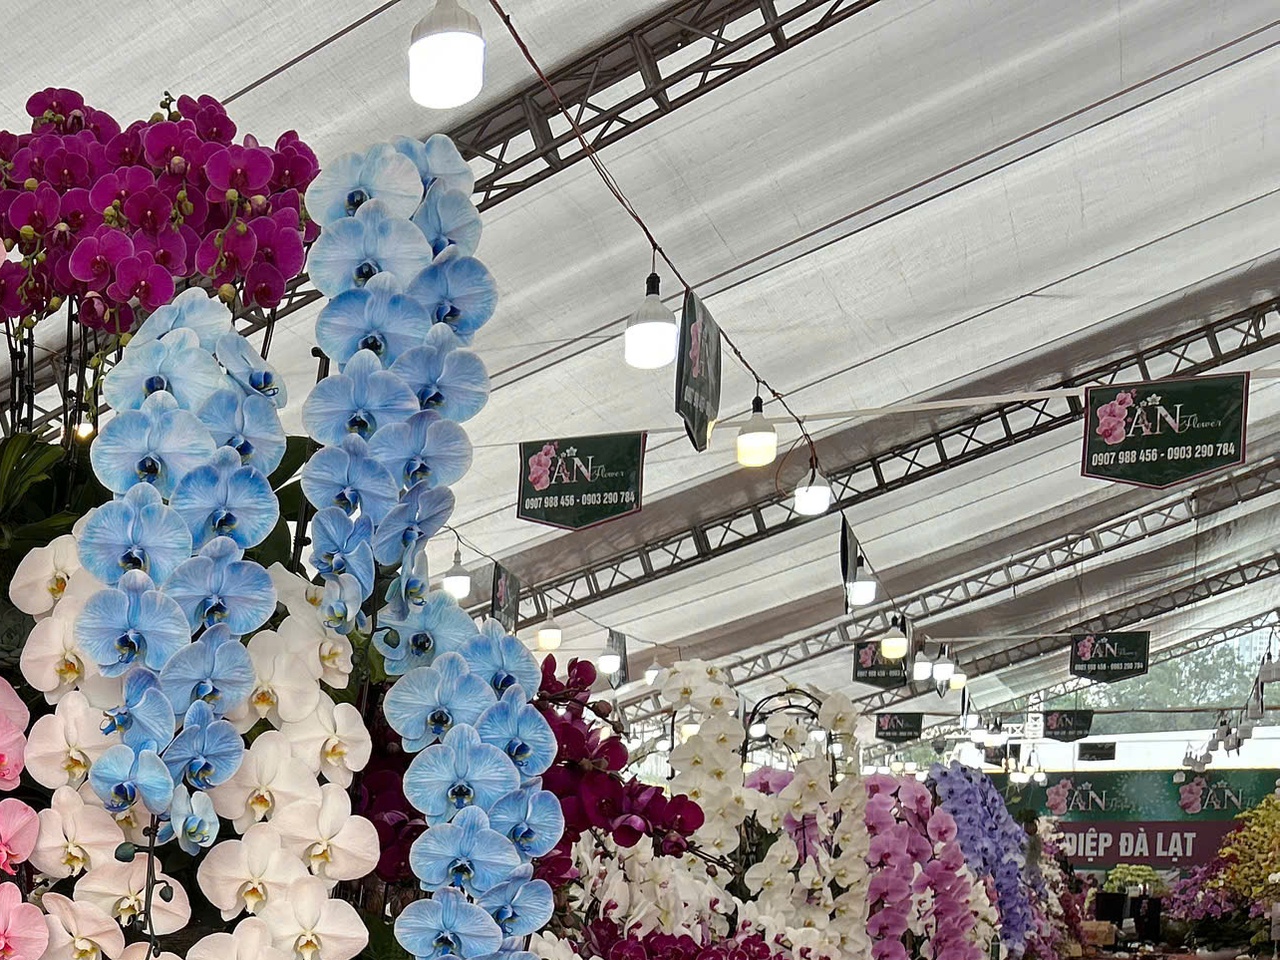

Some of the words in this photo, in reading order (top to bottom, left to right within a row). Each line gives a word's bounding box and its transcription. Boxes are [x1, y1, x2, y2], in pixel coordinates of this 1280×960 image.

[1091, 452, 1116, 467] 0907
[1118, 450, 1137, 464] 988
[1139, 448, 1158, 463] 456
[1167, 445, 1192, 461] 0903
[1194, 443, 1214, 459] 290
[1216, 441, 1235, 456] 784
[544, 495, 559, 509] 988
[581, 493, 601, 506] 0903
[603, 491, 618, 504] 290
[1119, 827, 1149, 857] ĐÀ
[1155, 832, 1197, 862] LẠT
